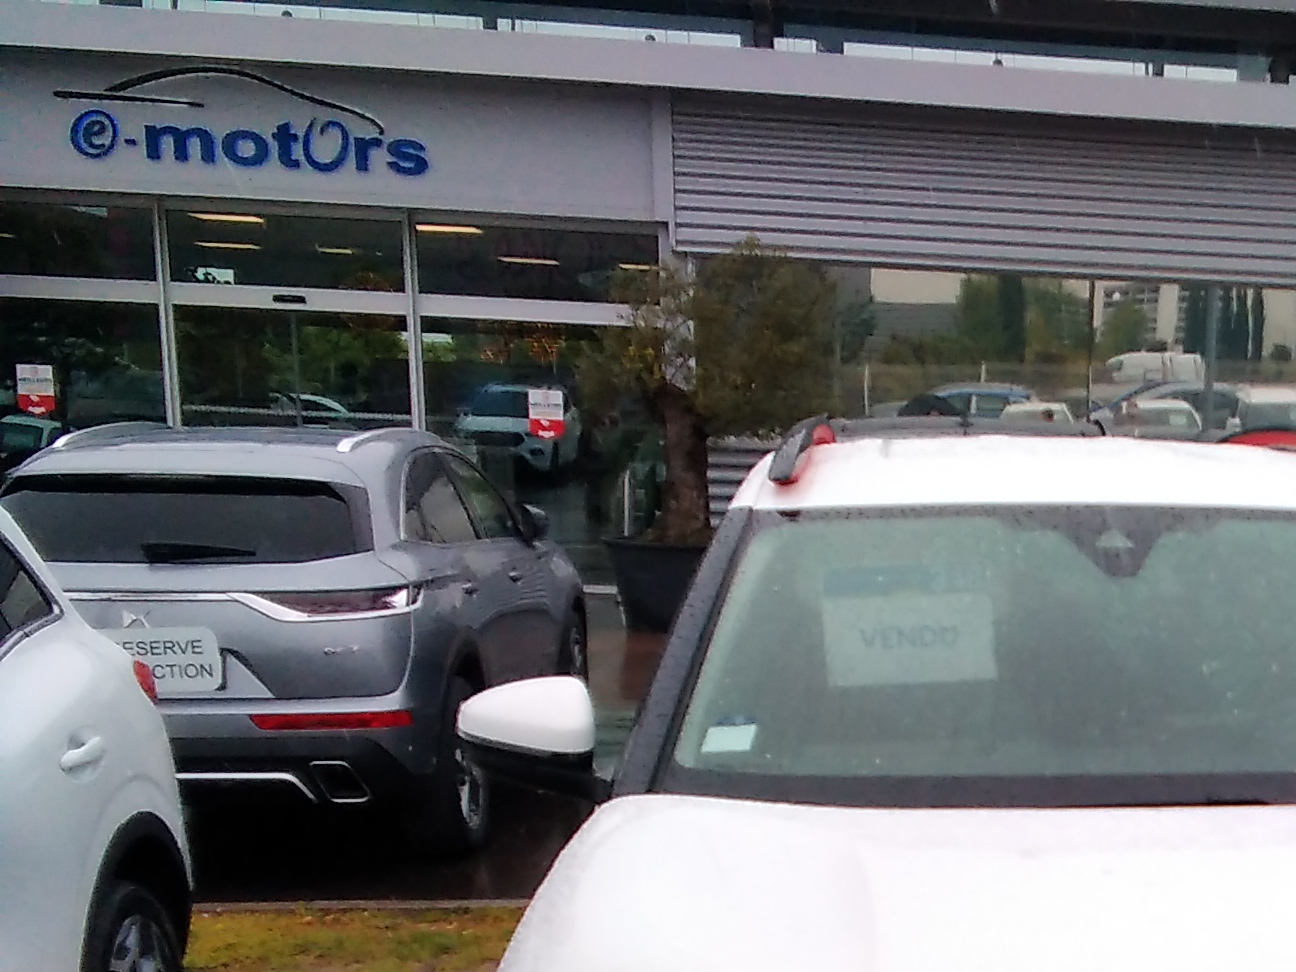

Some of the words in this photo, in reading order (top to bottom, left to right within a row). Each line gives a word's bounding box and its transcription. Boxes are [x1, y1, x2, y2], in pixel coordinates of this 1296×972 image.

[69, 108, 430, 176] e-motors
[115, 639, 204, 657] ESERVE
[150, 662, 215, 680] CTION
